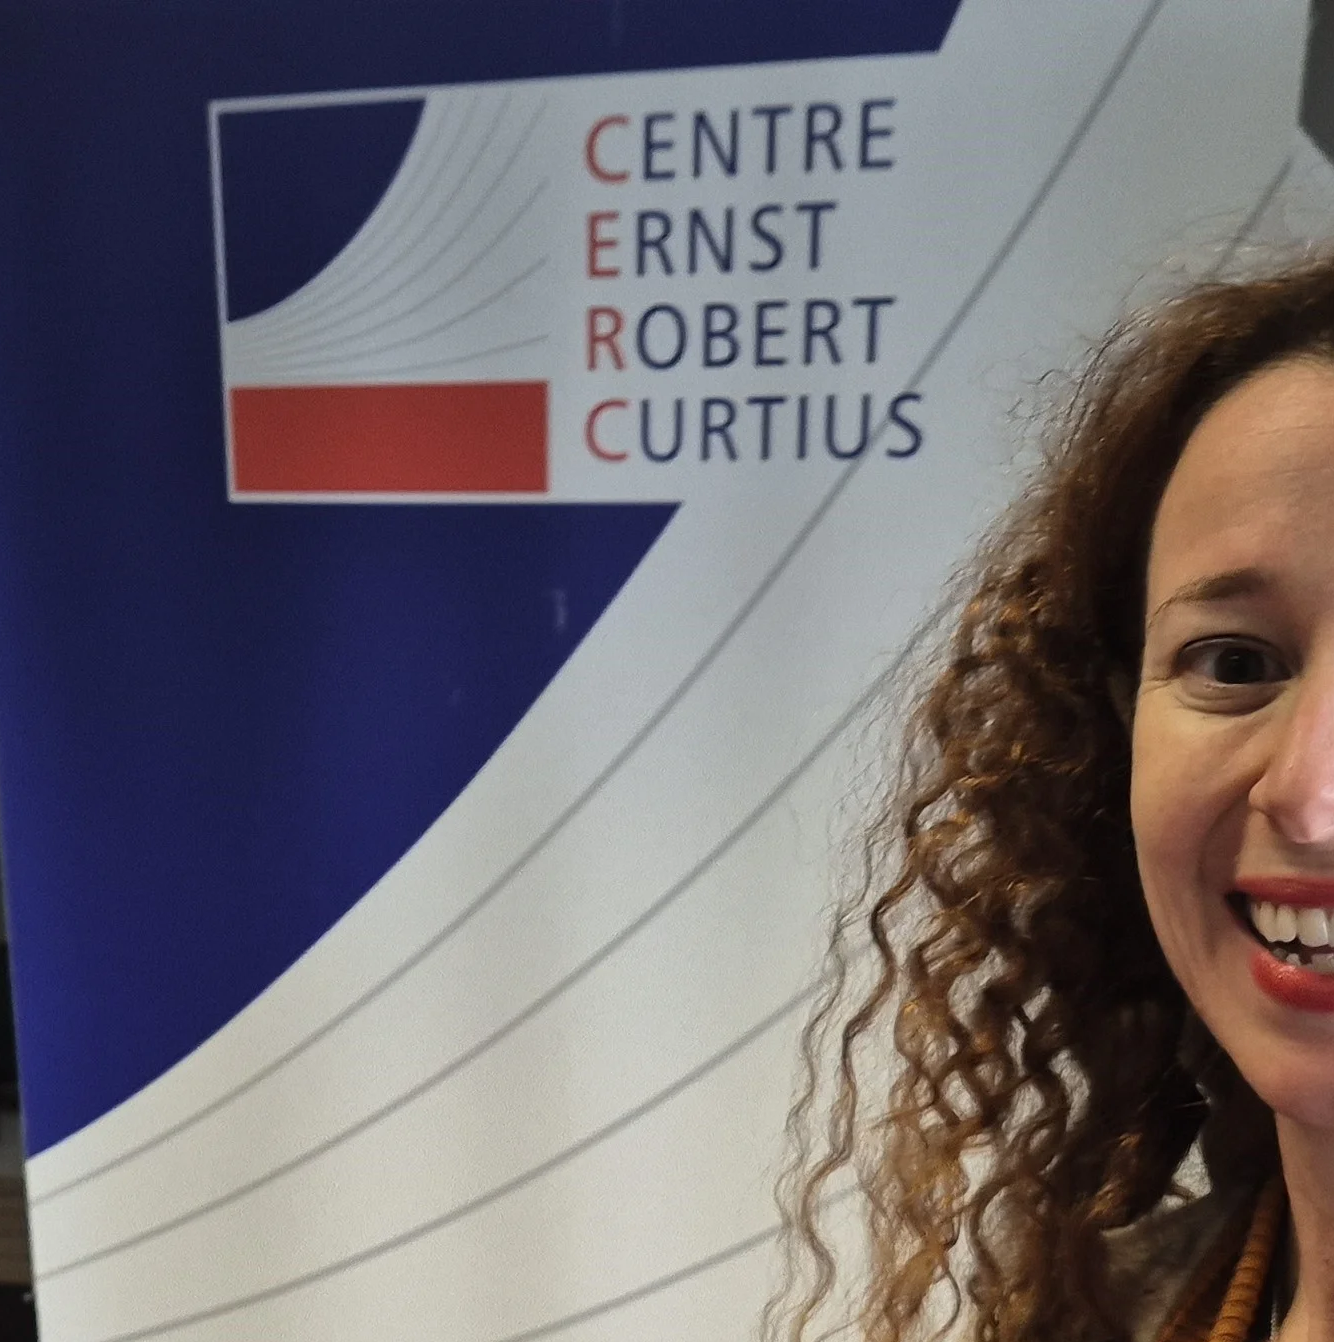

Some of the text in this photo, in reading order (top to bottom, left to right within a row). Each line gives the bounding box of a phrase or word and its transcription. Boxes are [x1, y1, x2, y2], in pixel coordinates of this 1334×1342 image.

[584, 98, 897, 184] CENTRE
[586, 201, 838, 279] ERNST
[586, 297, 897, 372] ROBERT
[584, 392, 924, 464] CURTIUS
